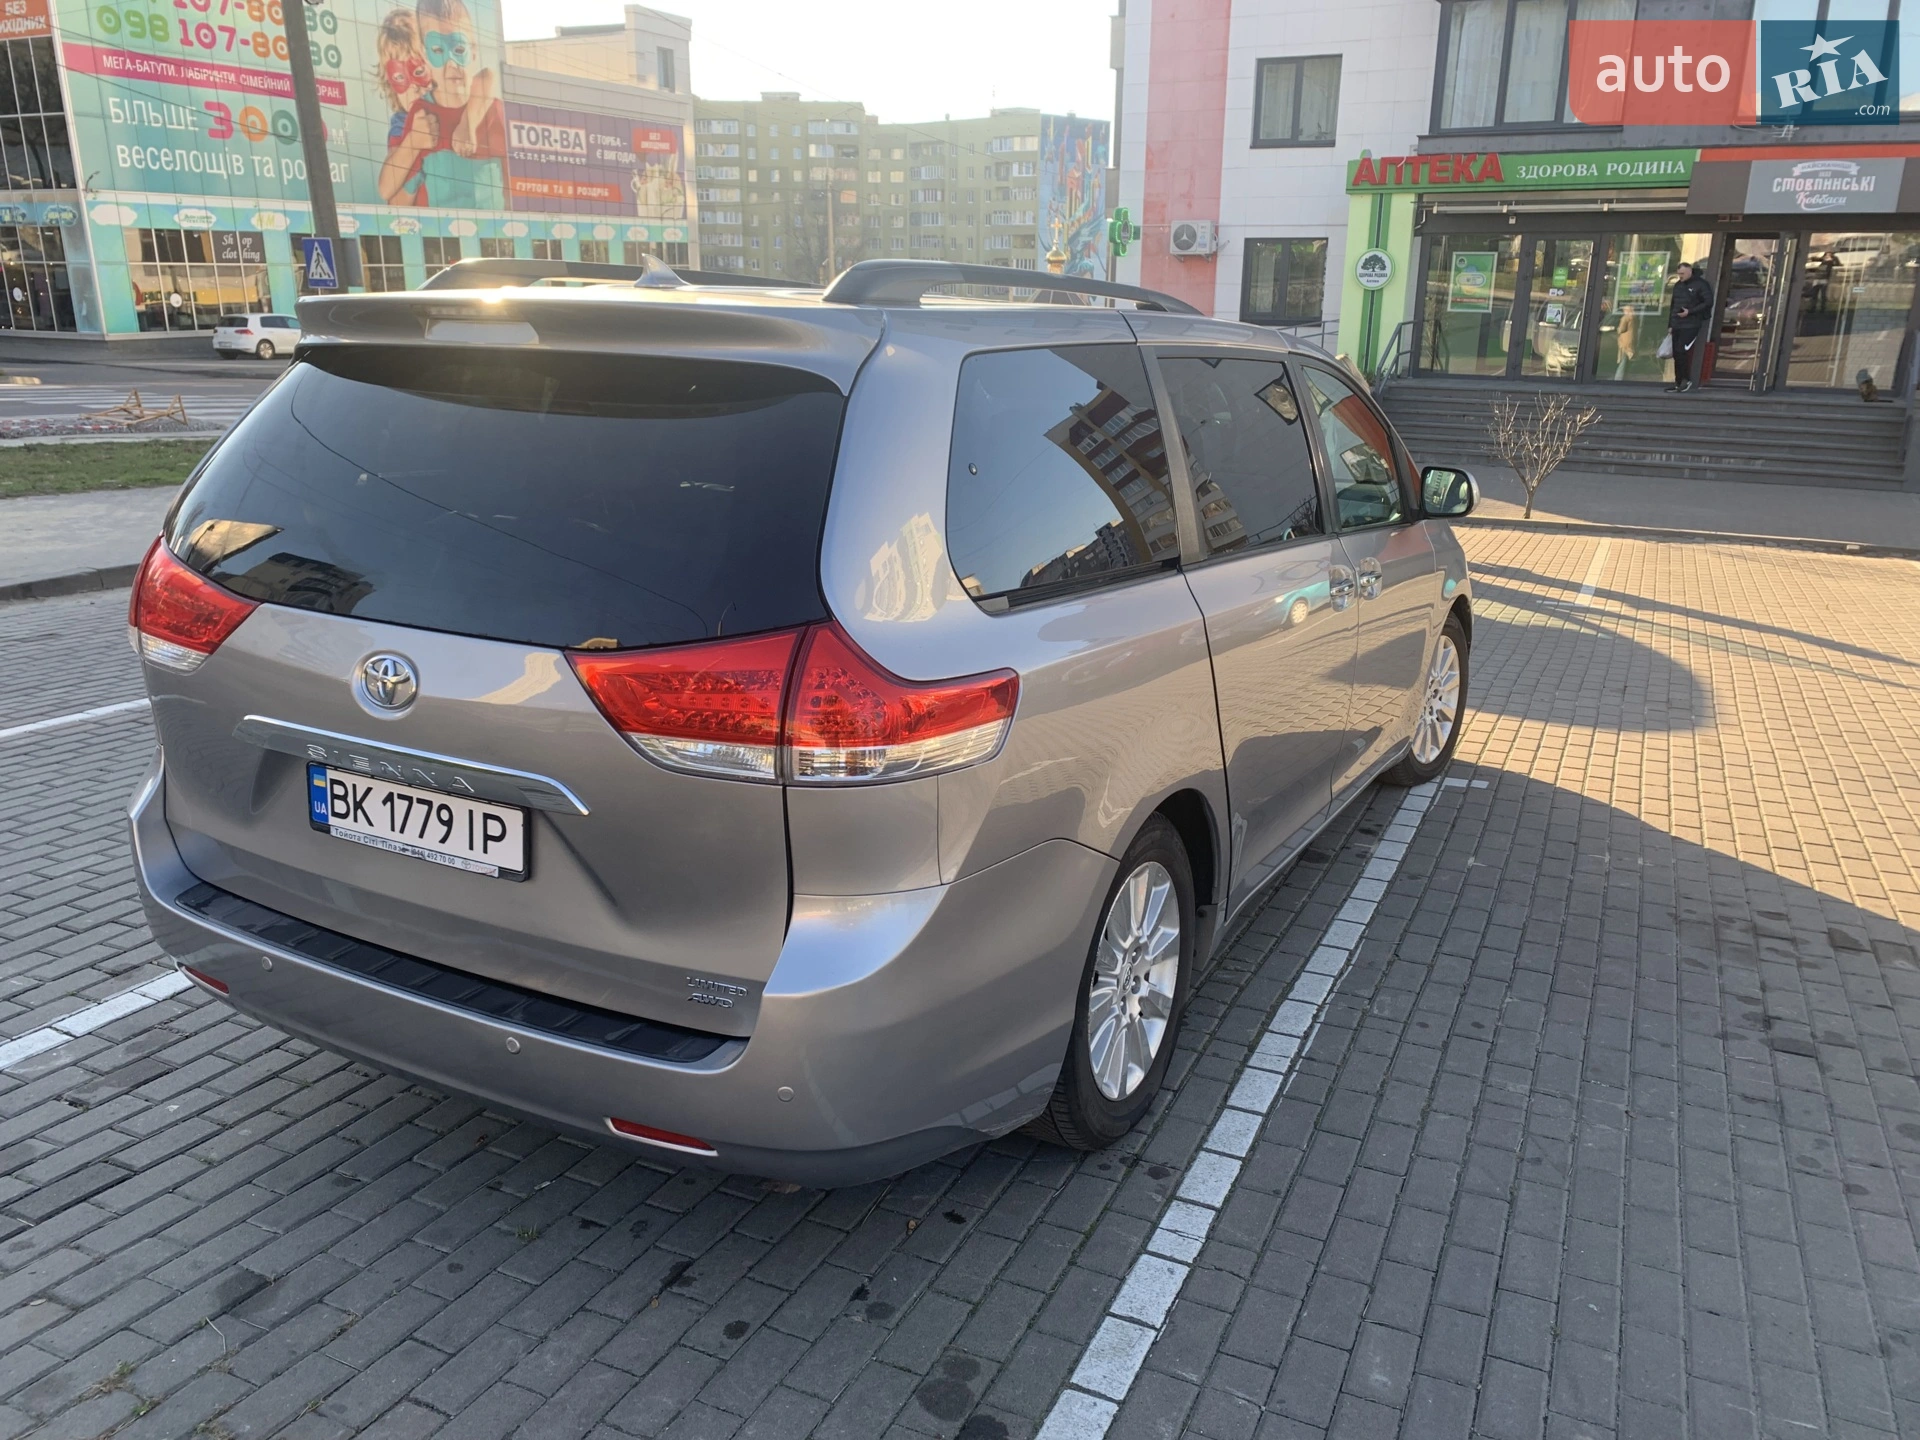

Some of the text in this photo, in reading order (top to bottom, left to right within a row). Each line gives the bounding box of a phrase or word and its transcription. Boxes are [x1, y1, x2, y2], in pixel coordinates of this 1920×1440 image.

[5, 1, 26, 15] БЕЗ
[96, 5, 170, 43] 098
[102, 54, 179, 77] МЕГА-БАТУТИ.
[239, 73, 291, 92] СІМЕЙНИЙ
[108, 97, 199, 131] БІЛЬШЕ
[204, 100, 328, 146] 300
[512, 124, 584, 151] TOR-BA
[116, 144, 349, 185] веселощів та роаг
[1352, 152, 1505, 187] АПТЕКА
[1516, 160, 1686, 180] ЗДОРОВА РОДИНА
[221, 233, 253, 248] Shop
[221, 247, 260, 262] clothing
[306, 744, 475, 793] SIENNA
[314, 800, 327, 815] UA
[329, 778, 507, 854] BK 1779 IP
[334, 827, 361, 842] Тойота
